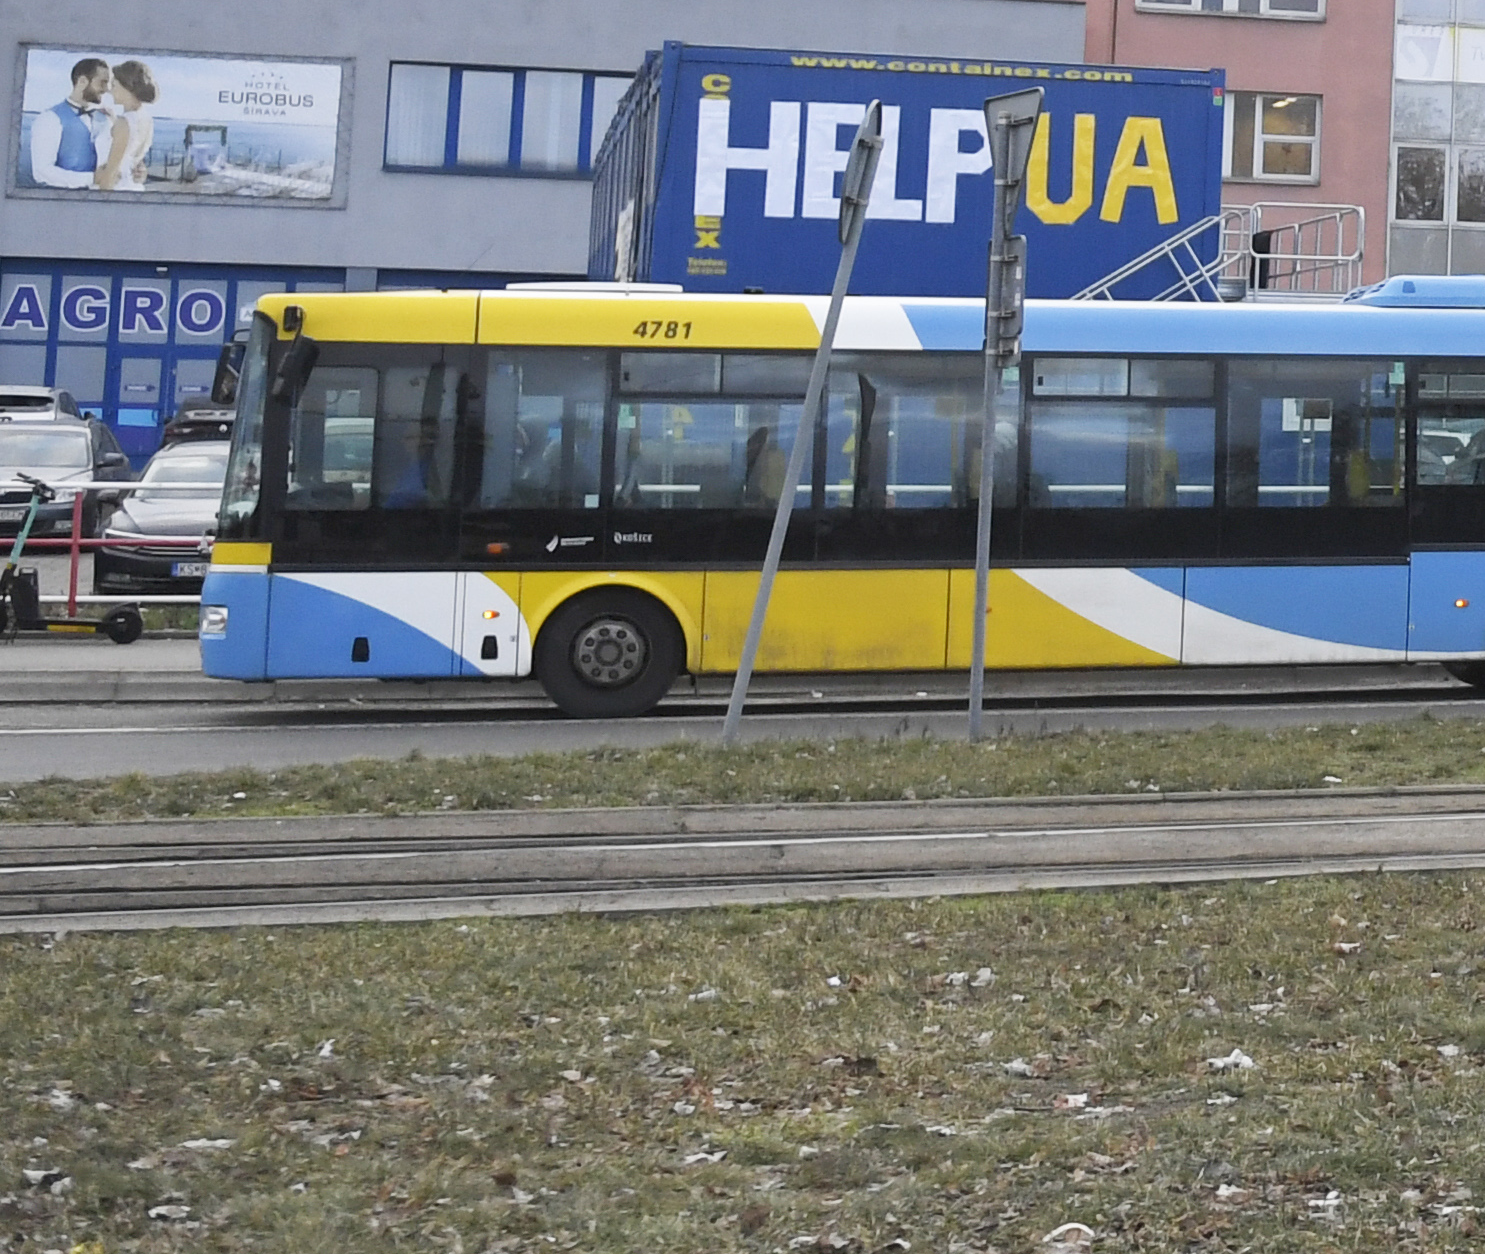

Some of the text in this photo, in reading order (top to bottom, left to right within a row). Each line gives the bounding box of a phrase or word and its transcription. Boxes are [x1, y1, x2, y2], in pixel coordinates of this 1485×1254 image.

[790, 56, 1134, 82] www.containex.com
[244, 81, 290, 91] HOTEL
[218, 90, 314, 108] EUROBUS
[693, 97, 1179, 225] HELP UA
[0, 284, 227, 336] AGRO
[632, 320, 693, 340] 4781
